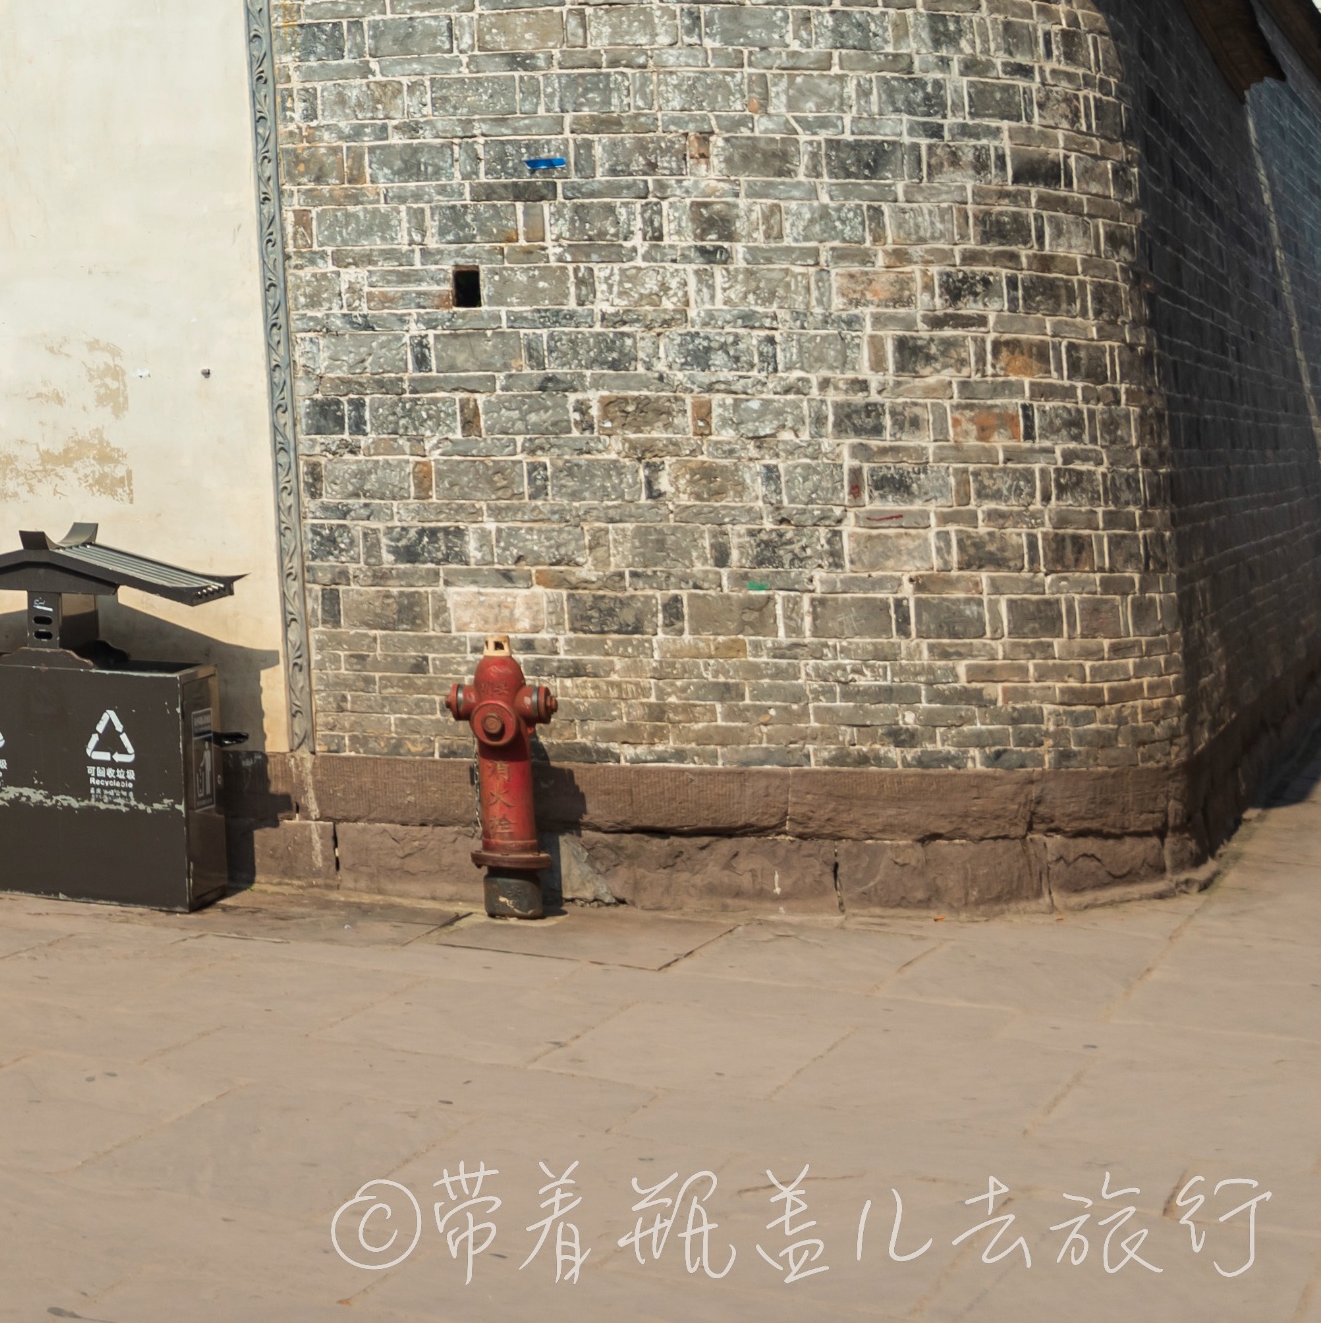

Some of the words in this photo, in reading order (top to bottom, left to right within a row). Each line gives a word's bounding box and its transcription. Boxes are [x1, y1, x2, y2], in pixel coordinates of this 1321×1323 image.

[86, 765, 136, 781] 可回收垃圾
[89, 777, 134, 789] Recyclable
[486, 760, 515, 835] 消火栓
